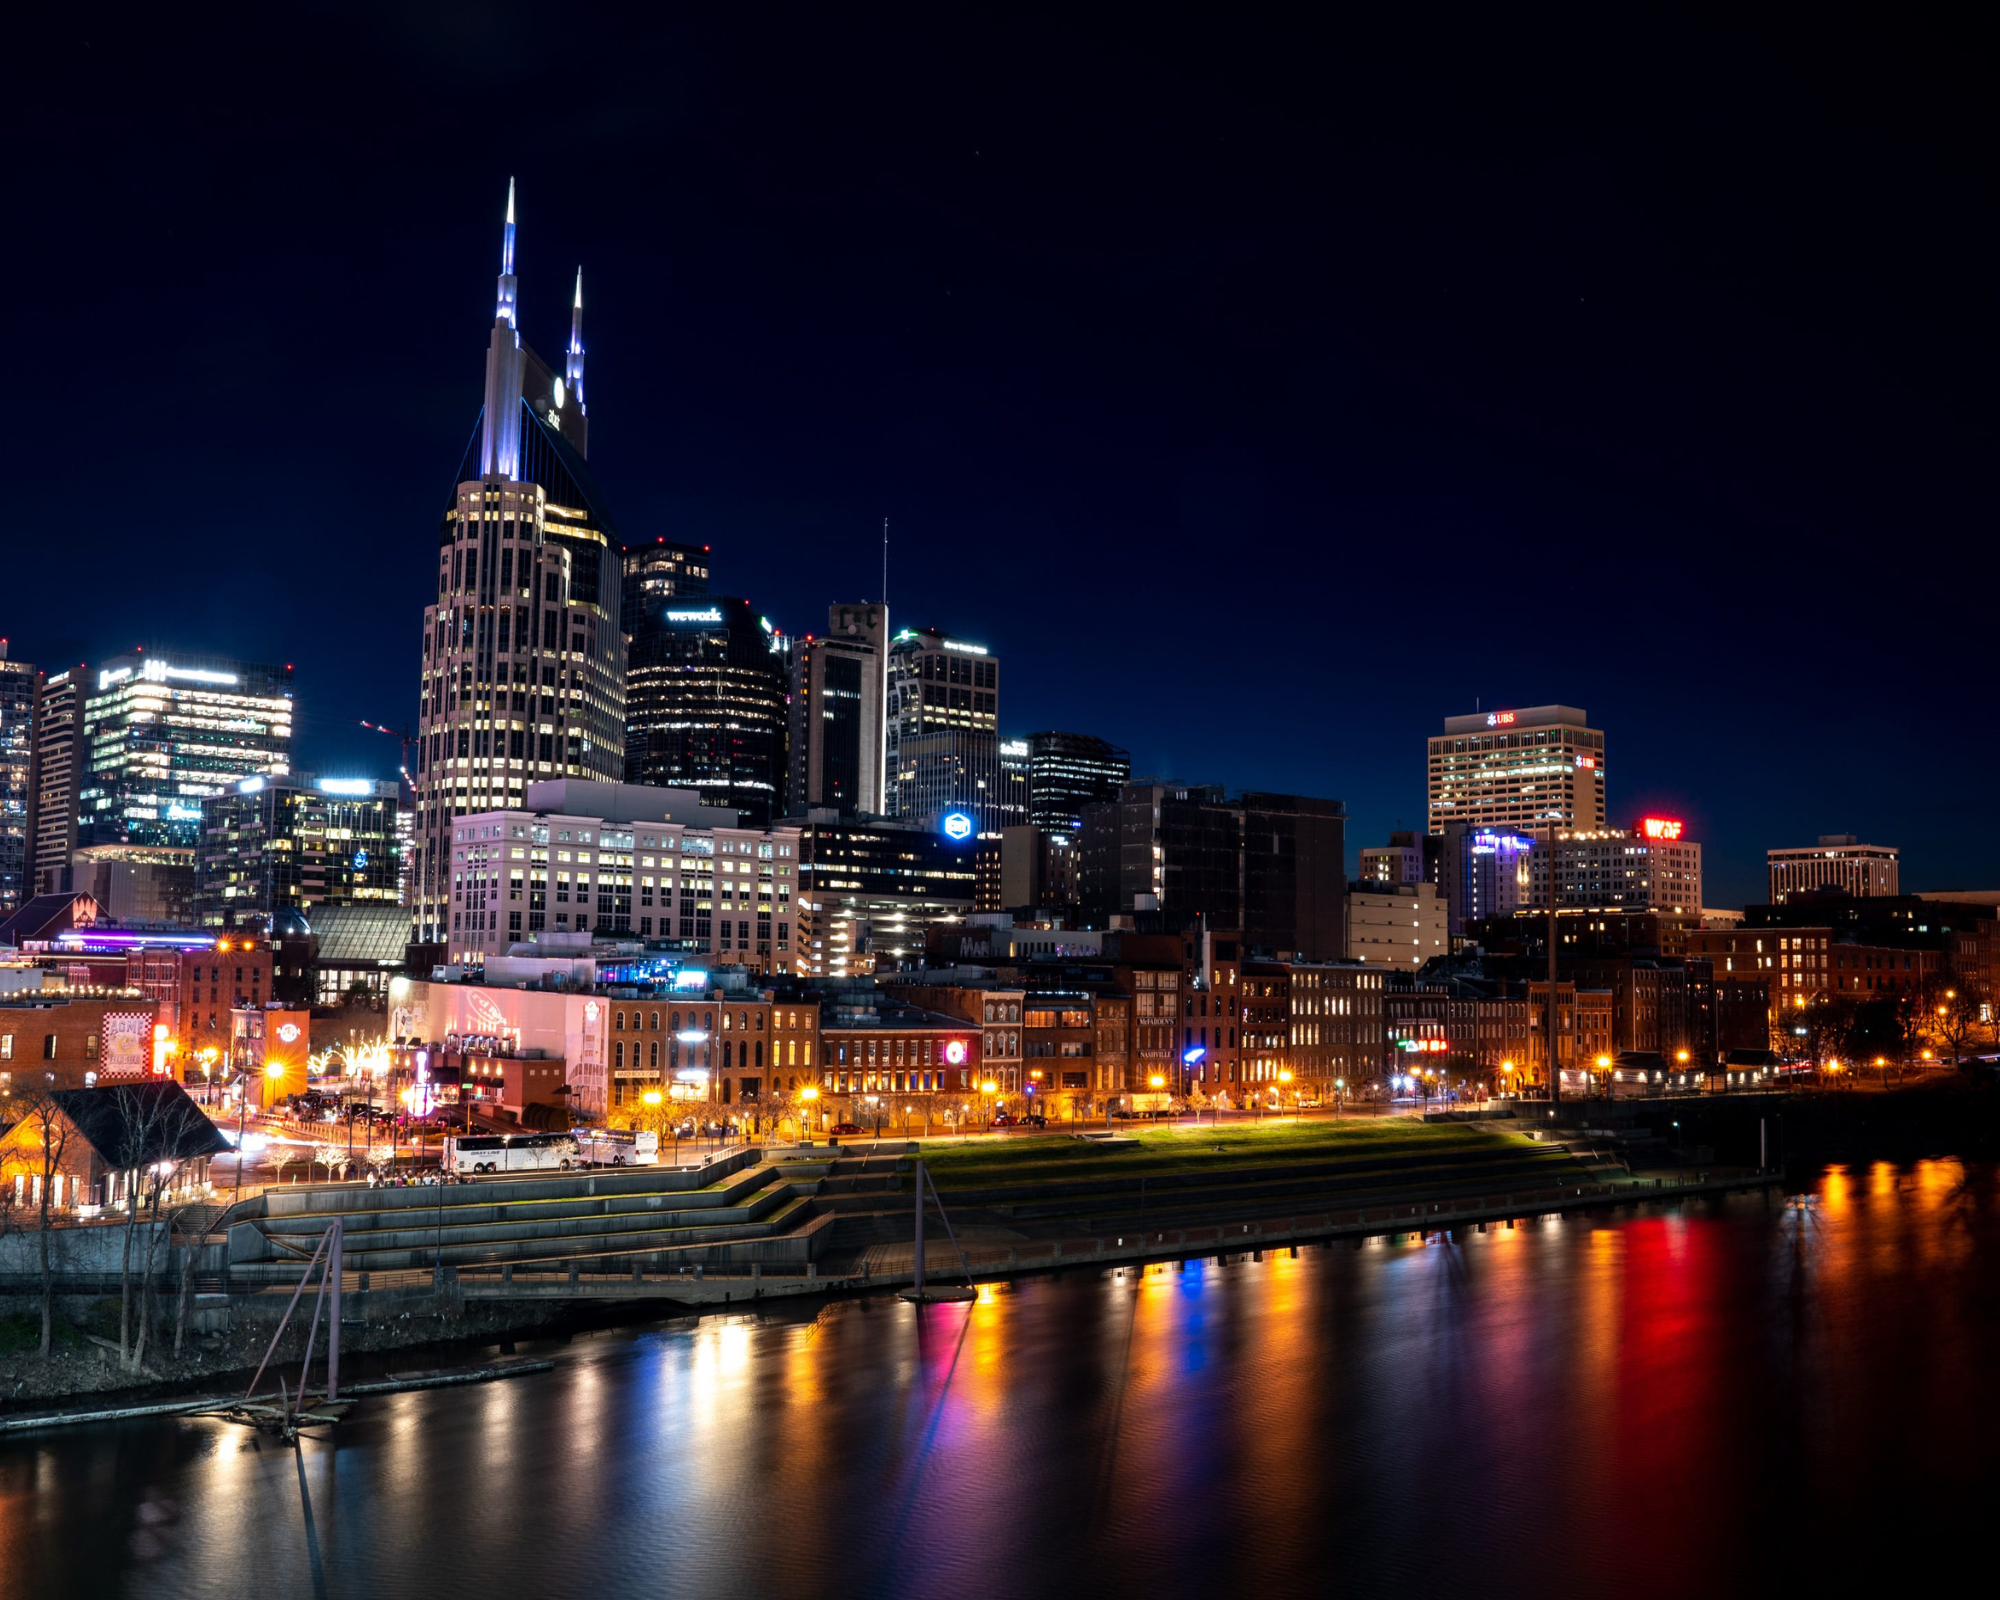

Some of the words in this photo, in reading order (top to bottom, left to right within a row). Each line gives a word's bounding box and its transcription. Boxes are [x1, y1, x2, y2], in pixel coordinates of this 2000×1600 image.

[666, 607, 722, 621] wework
[1497, 712, 1514, 724] UBS
[1582, 757, 1595, 768] UBS
[109, 1020, 144, 1037] ACME
